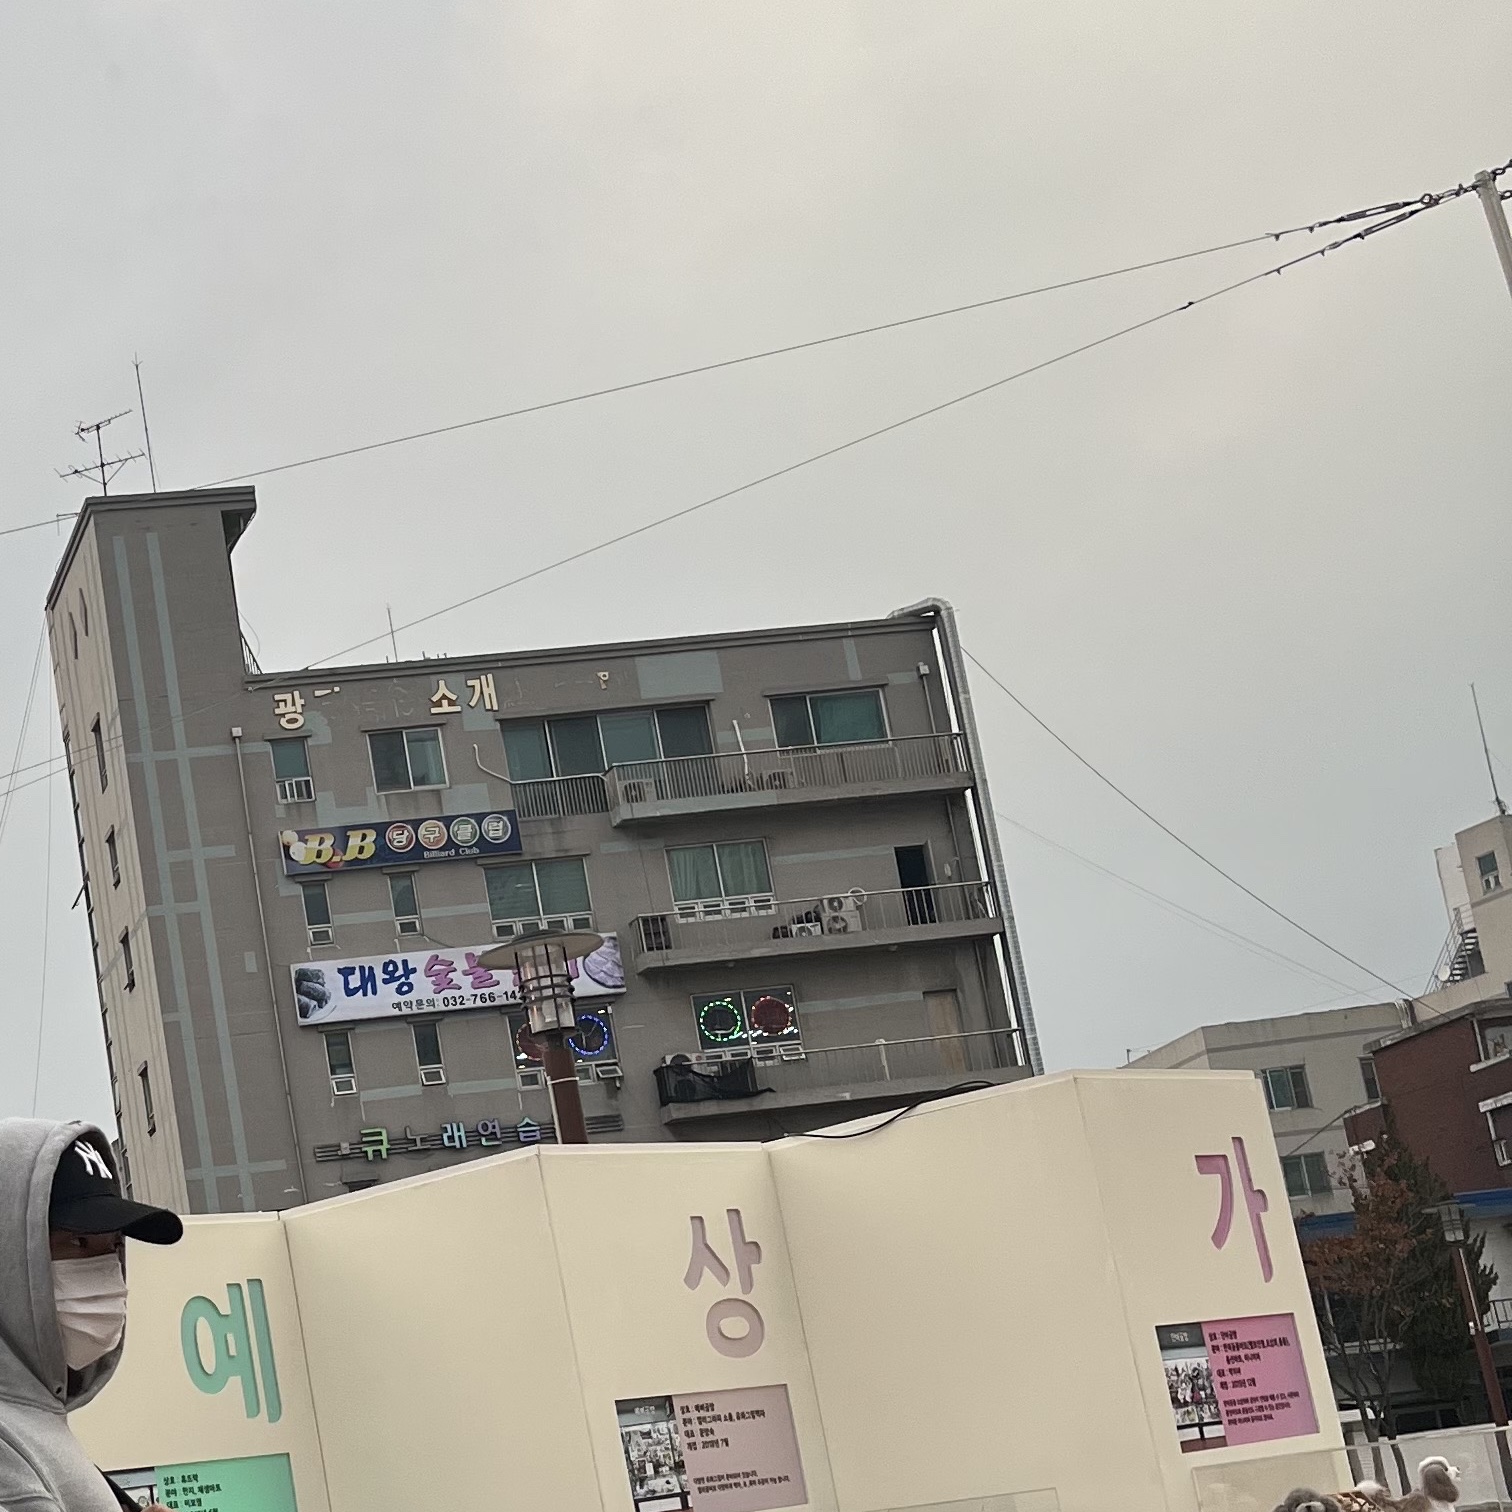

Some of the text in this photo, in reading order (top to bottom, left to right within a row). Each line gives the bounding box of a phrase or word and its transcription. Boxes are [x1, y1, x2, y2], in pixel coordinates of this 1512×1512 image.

[180, 1277, 283, 1424] 예
[683, 1208, 764, 1358] 상
[1194, 1136, 1274, 1283] 가
